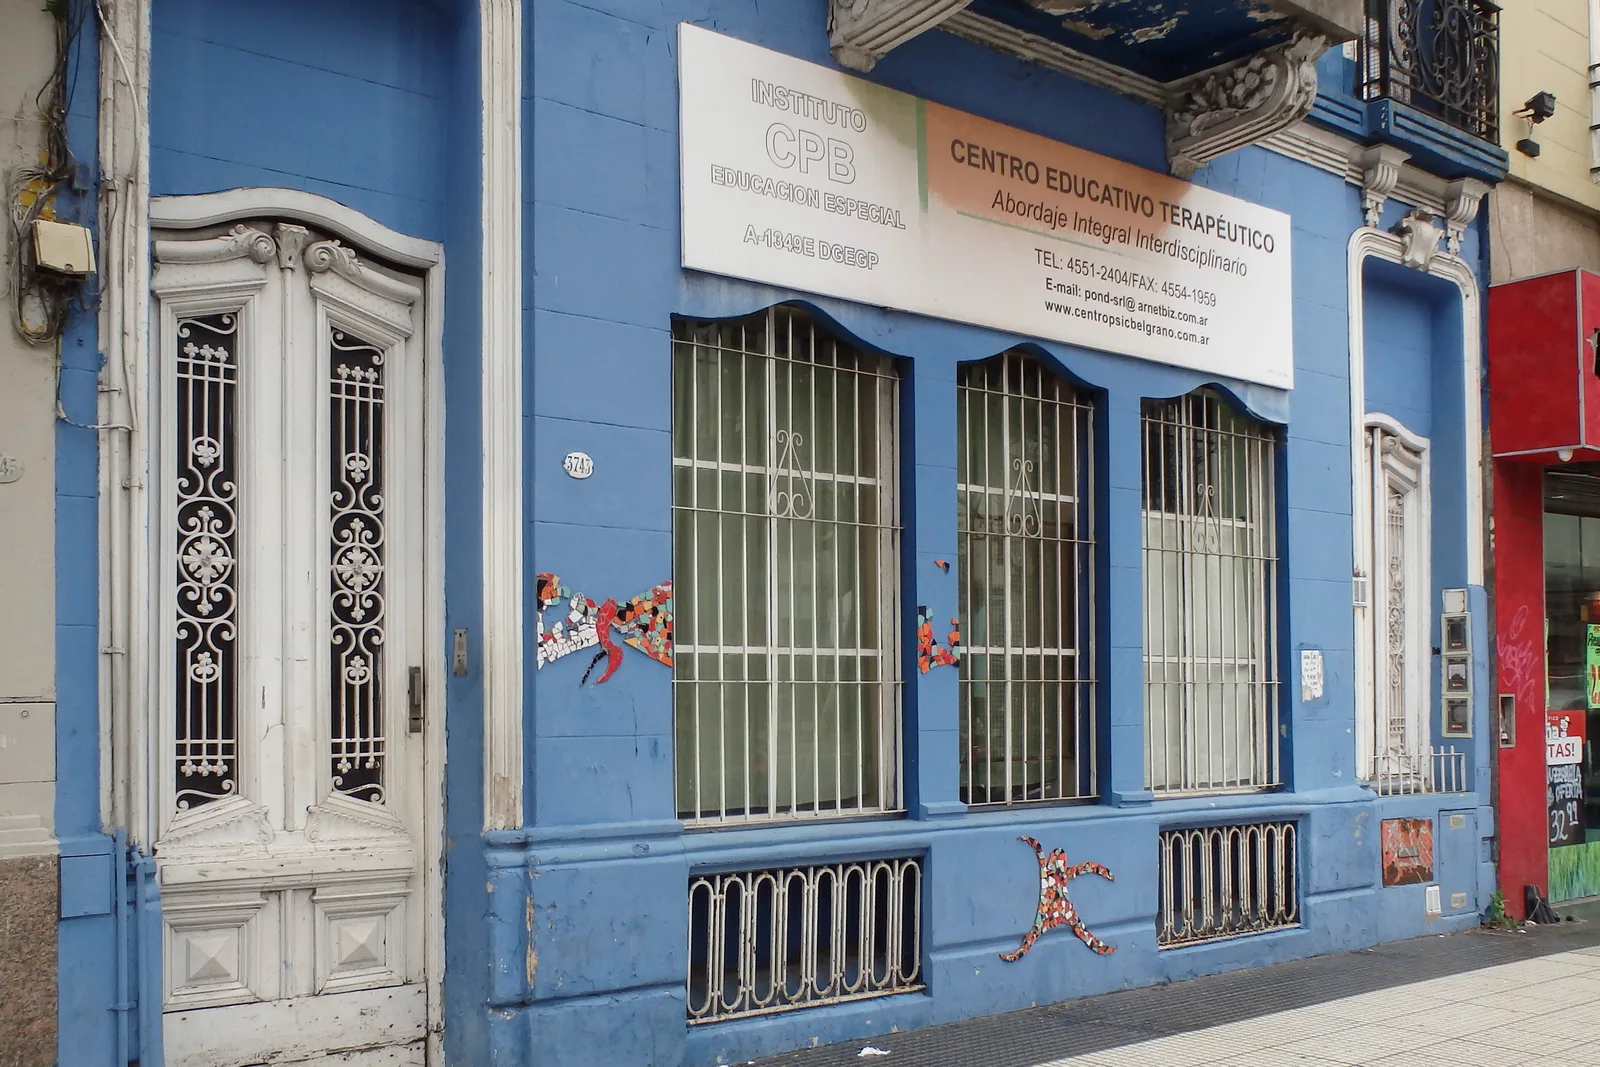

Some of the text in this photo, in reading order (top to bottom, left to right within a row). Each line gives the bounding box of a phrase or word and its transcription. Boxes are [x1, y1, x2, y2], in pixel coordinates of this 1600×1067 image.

[751, 78, 867, 132] INSTITUTO
[765, 123, 856, 185] CPB
[710, 164, 906, 230] EDUCACION ESPECIAL
[951, 139, 1275, 253] CENTRO EDUCATIVO TERAPÉUTICO
[743, 224, 879, 270] A-1349E DGEGP
[992, 189, 1248, 277] Abordaje Integral Interdisciplinario
[1034, 248, 1217, 308] TEL: 4551-2404/FAX: 4554-1959
[1046, 277, 1082, 298] E-mail:
[1045, 299, 1210, 346] www.centropsicbelgrano.com.ar
[567, 456, 591, 475] 3743
[1547, 742, 1575, 758] TAS!
[1550, 809, 1568, 843] 32
